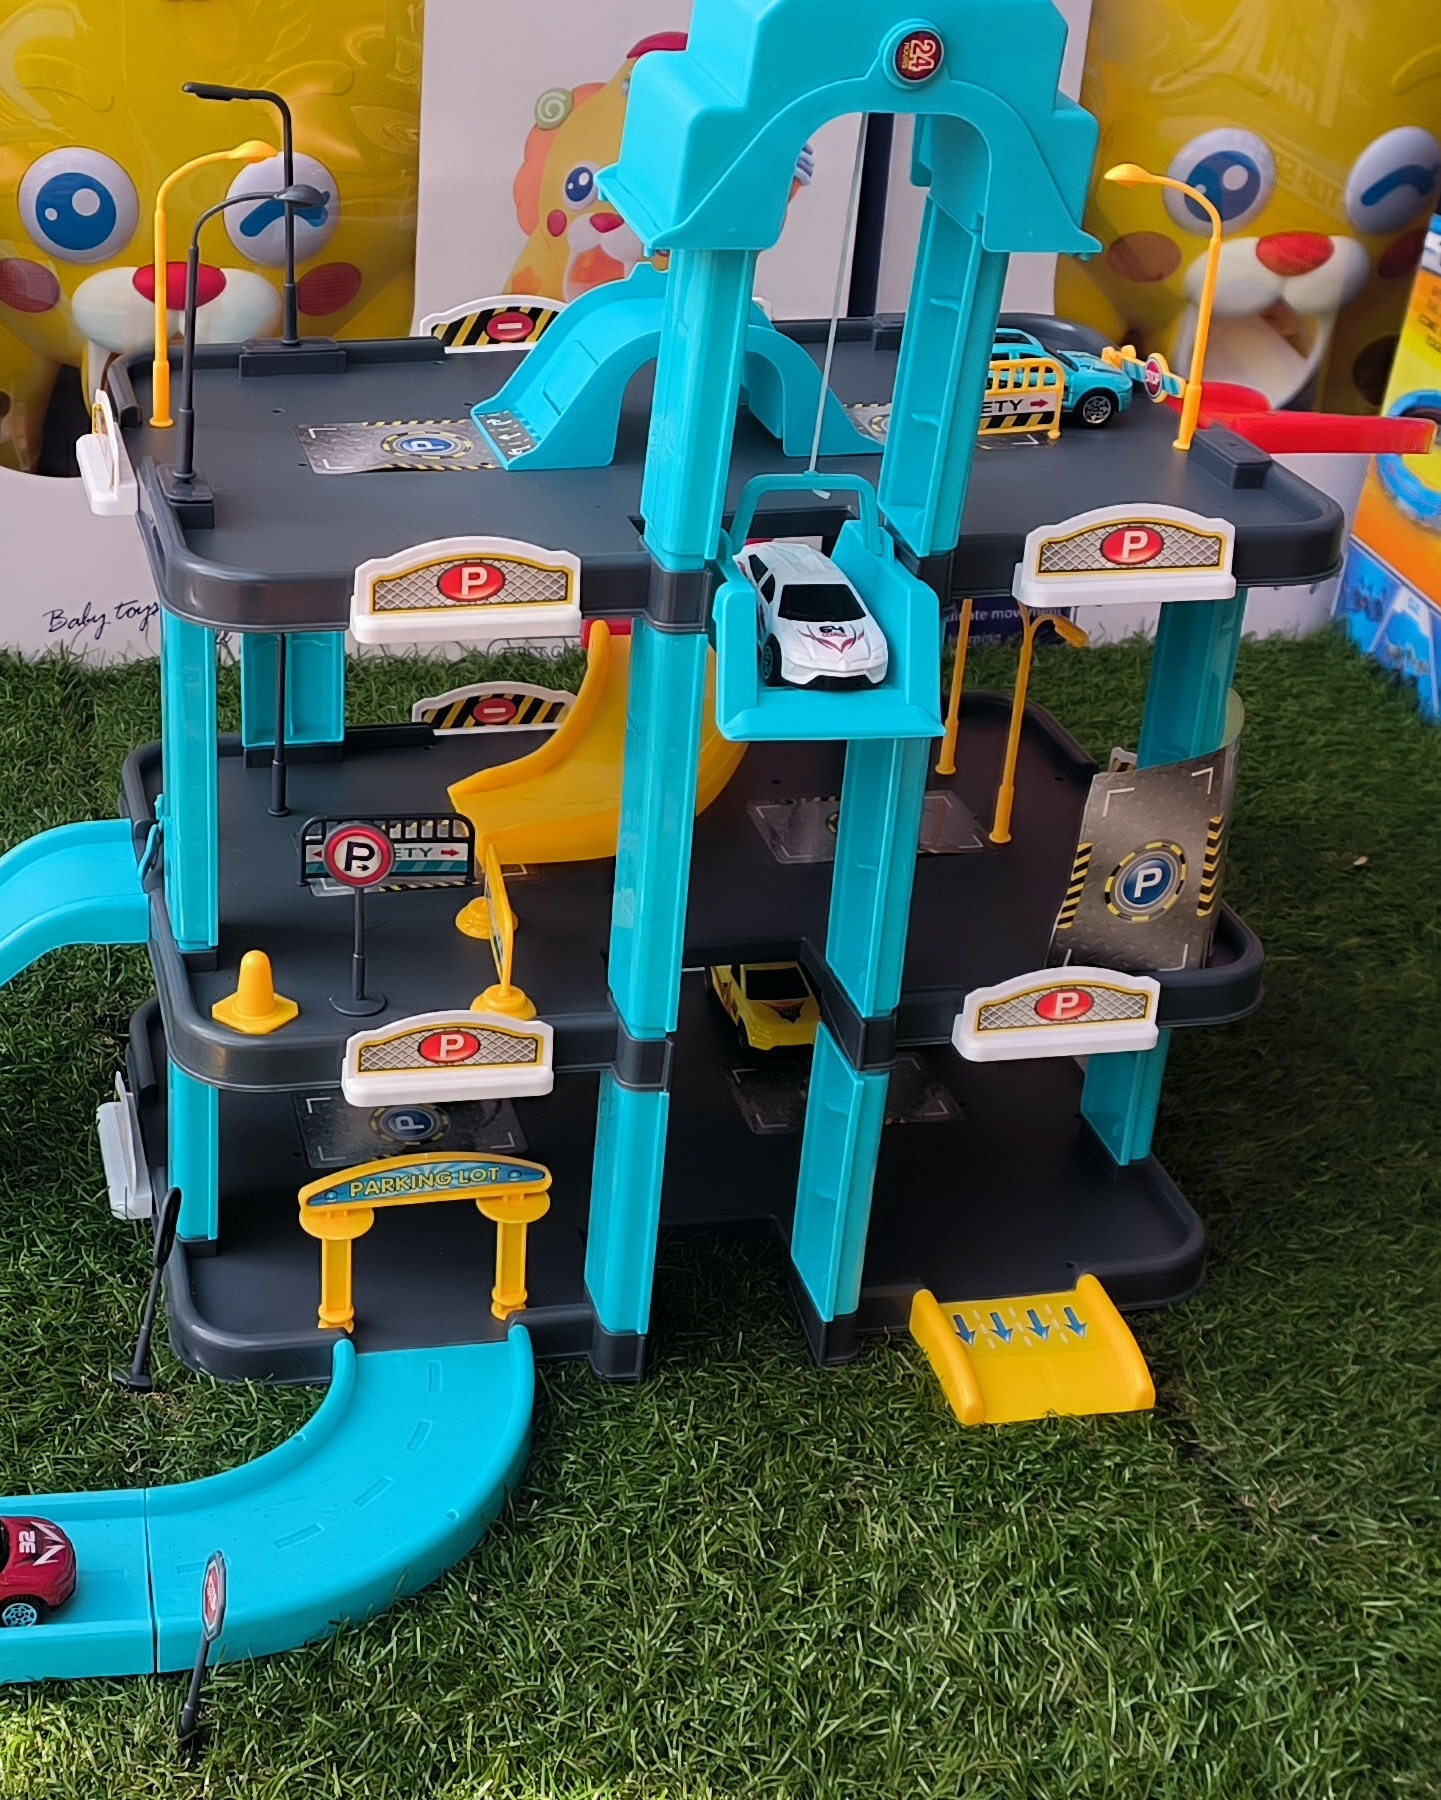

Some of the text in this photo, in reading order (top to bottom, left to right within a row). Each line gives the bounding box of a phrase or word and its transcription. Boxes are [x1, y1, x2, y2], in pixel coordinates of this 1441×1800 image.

[982, 398, 1023, 413] ETY
[1122, 530, 1148, 559] P
[461, 566, 488, 596] P
[42, 601, 111, 640] Baby
[343, 841, 434, 872] P ETY
[1133, 867, 1162, 901] P
[1054, 991, 1080, 1018] P
[439, 1034, 465, 1059] P
[349, 1166, 502, 1198] PARKING LOT
